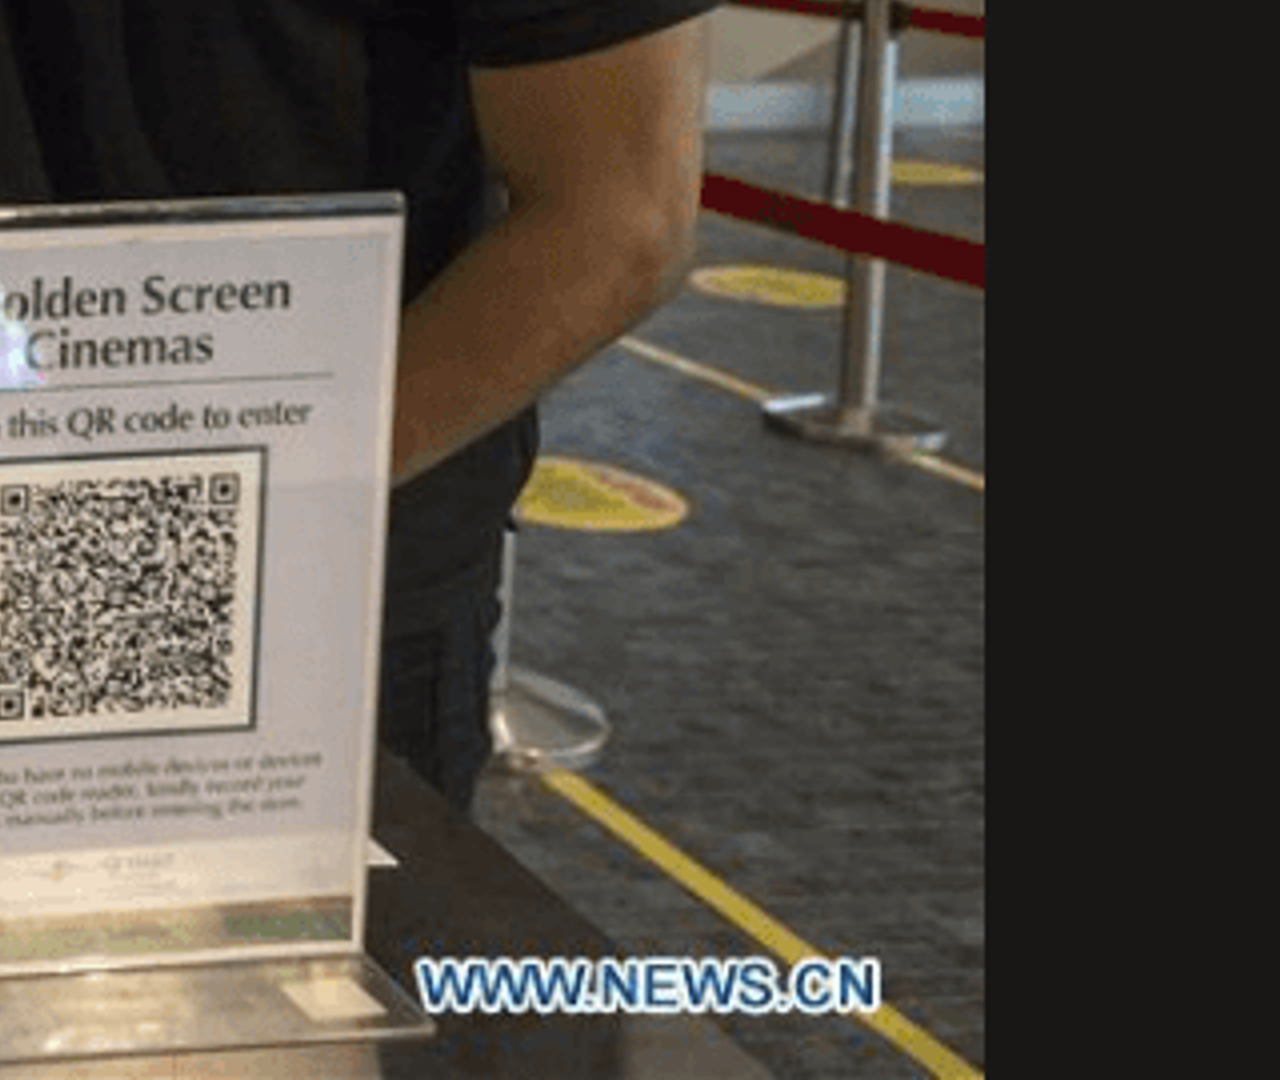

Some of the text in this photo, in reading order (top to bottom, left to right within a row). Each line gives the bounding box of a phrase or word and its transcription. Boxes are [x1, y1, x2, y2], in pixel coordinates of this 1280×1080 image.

[142, 275, 292, 316] Screen
[24, 328, 214, 372] Cinemas
[8, 409, 58, 439] this
[67, 407, 115, 437] QR
[123, 403, 194, 433] code
[203, 405, 230, 431] to
[238, 402, 312, 428] enter
